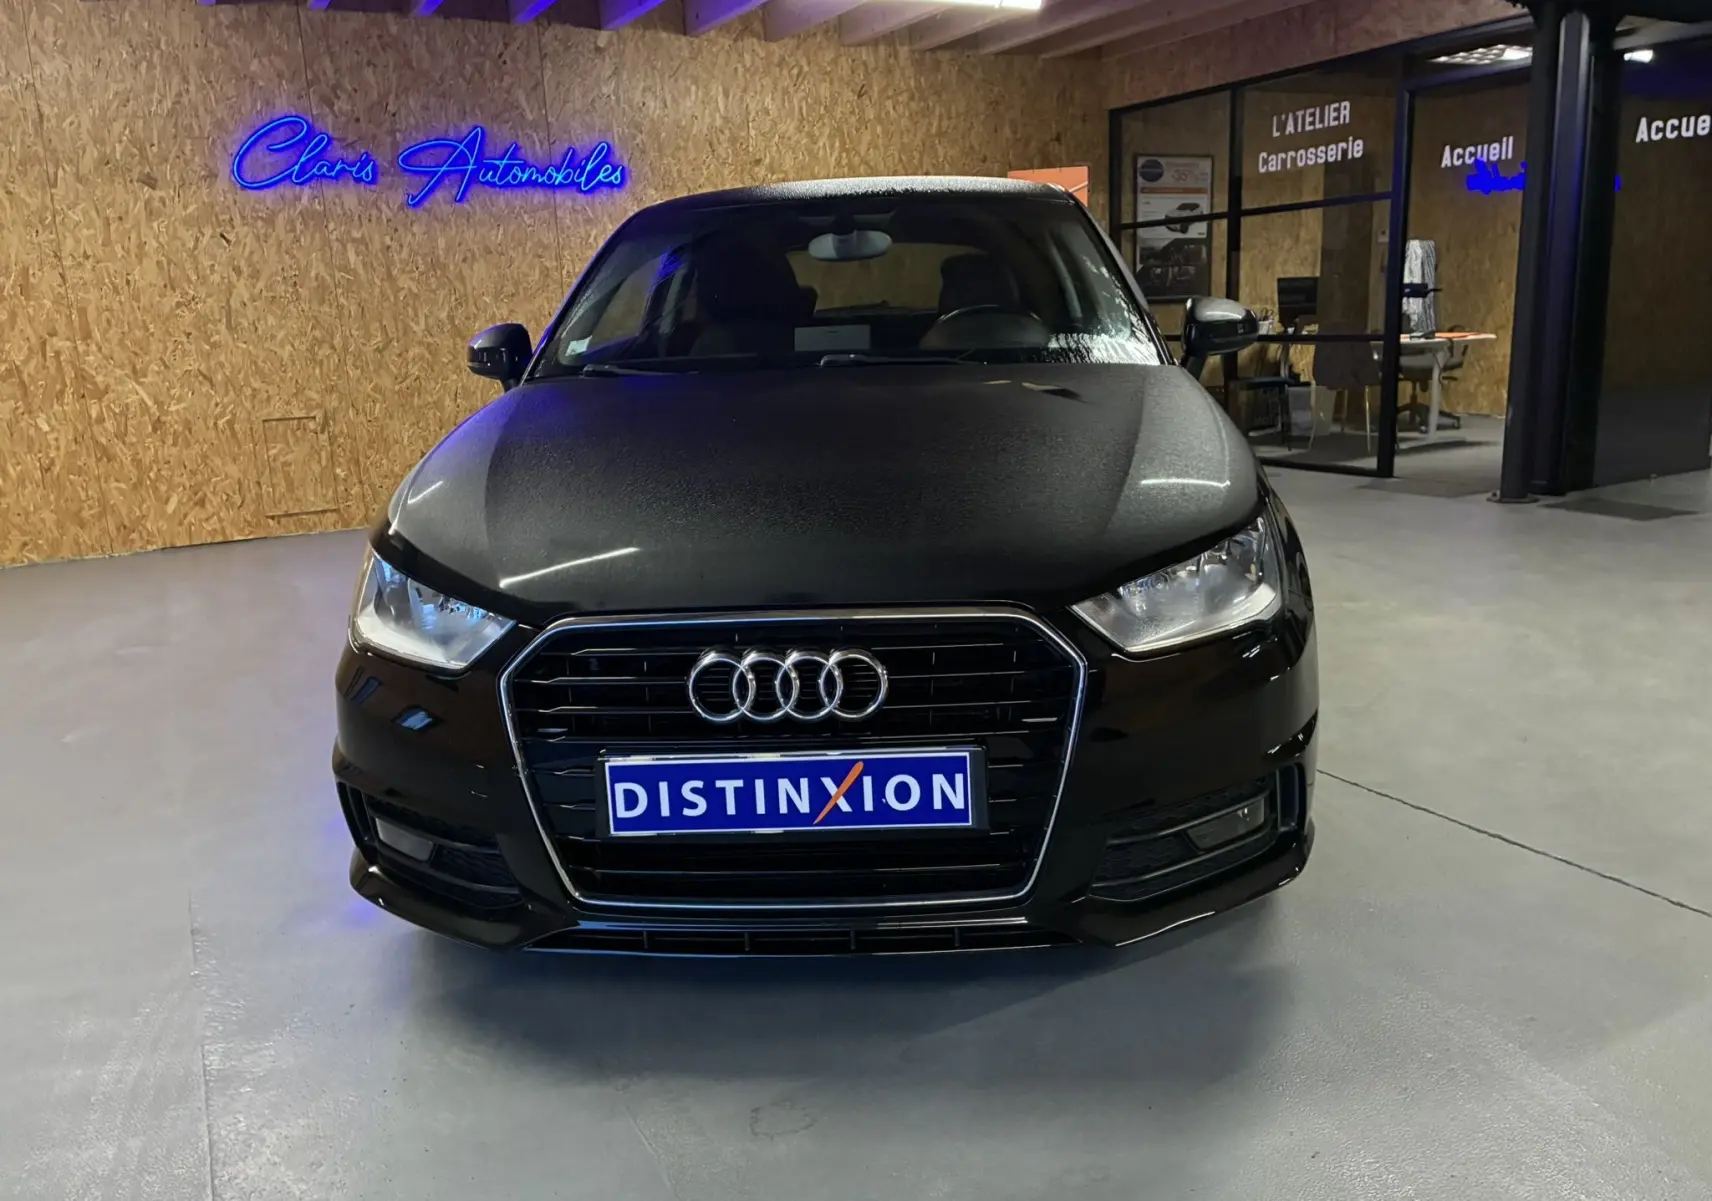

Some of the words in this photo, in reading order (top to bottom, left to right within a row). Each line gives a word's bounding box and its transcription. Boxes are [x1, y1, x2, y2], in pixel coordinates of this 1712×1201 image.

[1272, 101, 1351, 138] L'ATELIER
[1635, 114, 1711, 143] Accue
[232, 115, 376, 188] Claris
[398, 126, 625, 205] Automobiles
[1258, 136, 1364, 173] Carrosserie
[1441, 136, 1514, 168] Accueil
[614, 763, 965, 823] DISTINXION
